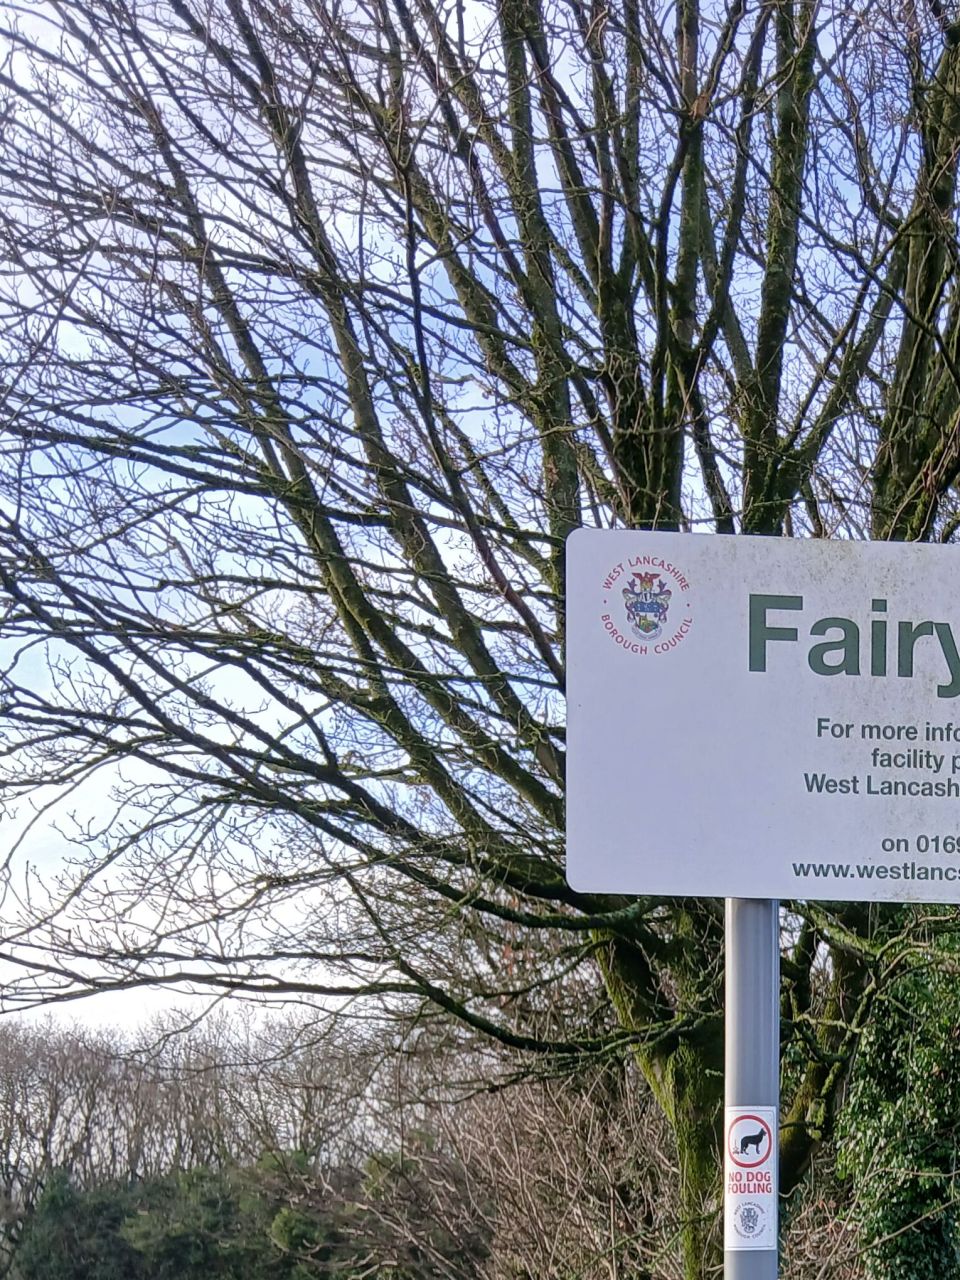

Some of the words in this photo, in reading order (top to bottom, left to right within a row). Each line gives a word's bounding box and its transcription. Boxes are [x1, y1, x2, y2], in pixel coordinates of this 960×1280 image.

[602, 562, 626, 591] WEST
[628, 556, 690, 592] LANCASHIRE
[601, 614, 648, 655] BOROUGH
[654, 618, 693, 654] COUNCIL
[817, 717, 855, 739] For
[861, 723, 919, 741] more
[870, 748, 945, 774] facility
[803, 773, 860, 795] West
[881, 838, 909, 853] on
[728, 1171, 743, 1182] NO
[746, 1171, 771, 1182] DOG
[728, 1182, 772, 1194] FOULING
